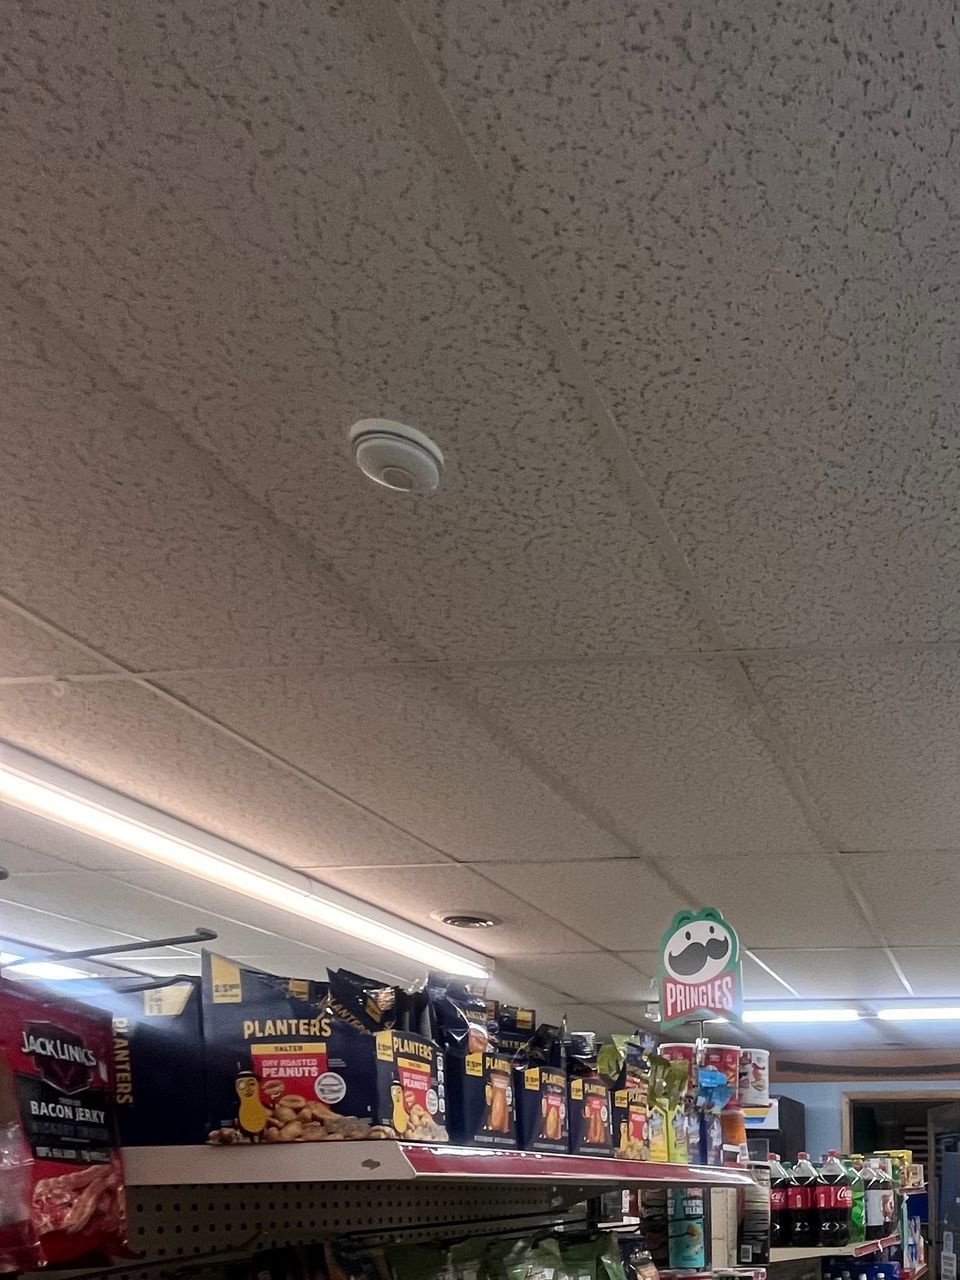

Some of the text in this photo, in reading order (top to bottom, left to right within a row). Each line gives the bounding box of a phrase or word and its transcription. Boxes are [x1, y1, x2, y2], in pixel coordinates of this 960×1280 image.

[666, 975, 733, 1016] PRINGLES
[243, 1018, 332, 1040] PLANTERS
[392, 1036, 433, 1061] PLANTERS
[261, 1066, 319, 1078] PEANUTS
[30, 1100, 73, 1119] BACON
[75, 1107, 105, 1124] JERKY
